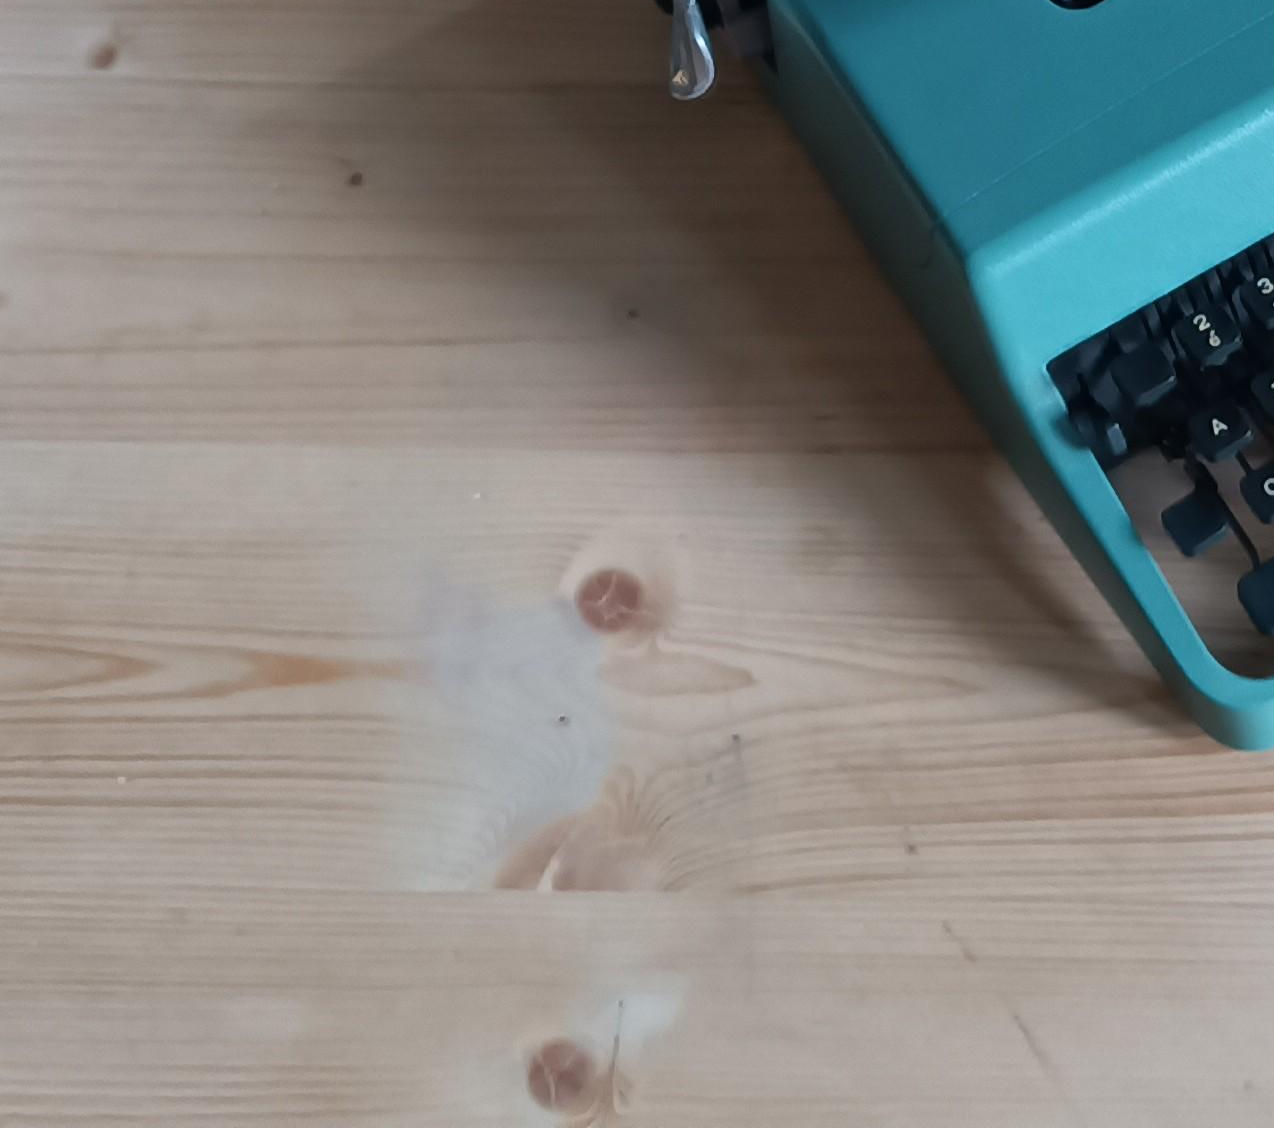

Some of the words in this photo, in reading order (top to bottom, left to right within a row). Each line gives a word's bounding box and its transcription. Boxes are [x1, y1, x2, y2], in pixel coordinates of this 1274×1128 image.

[1193, 314, 1211, 332] 2
[1257, 277, 1274, 295] 3
[1211, 417, 1229, 436] A
